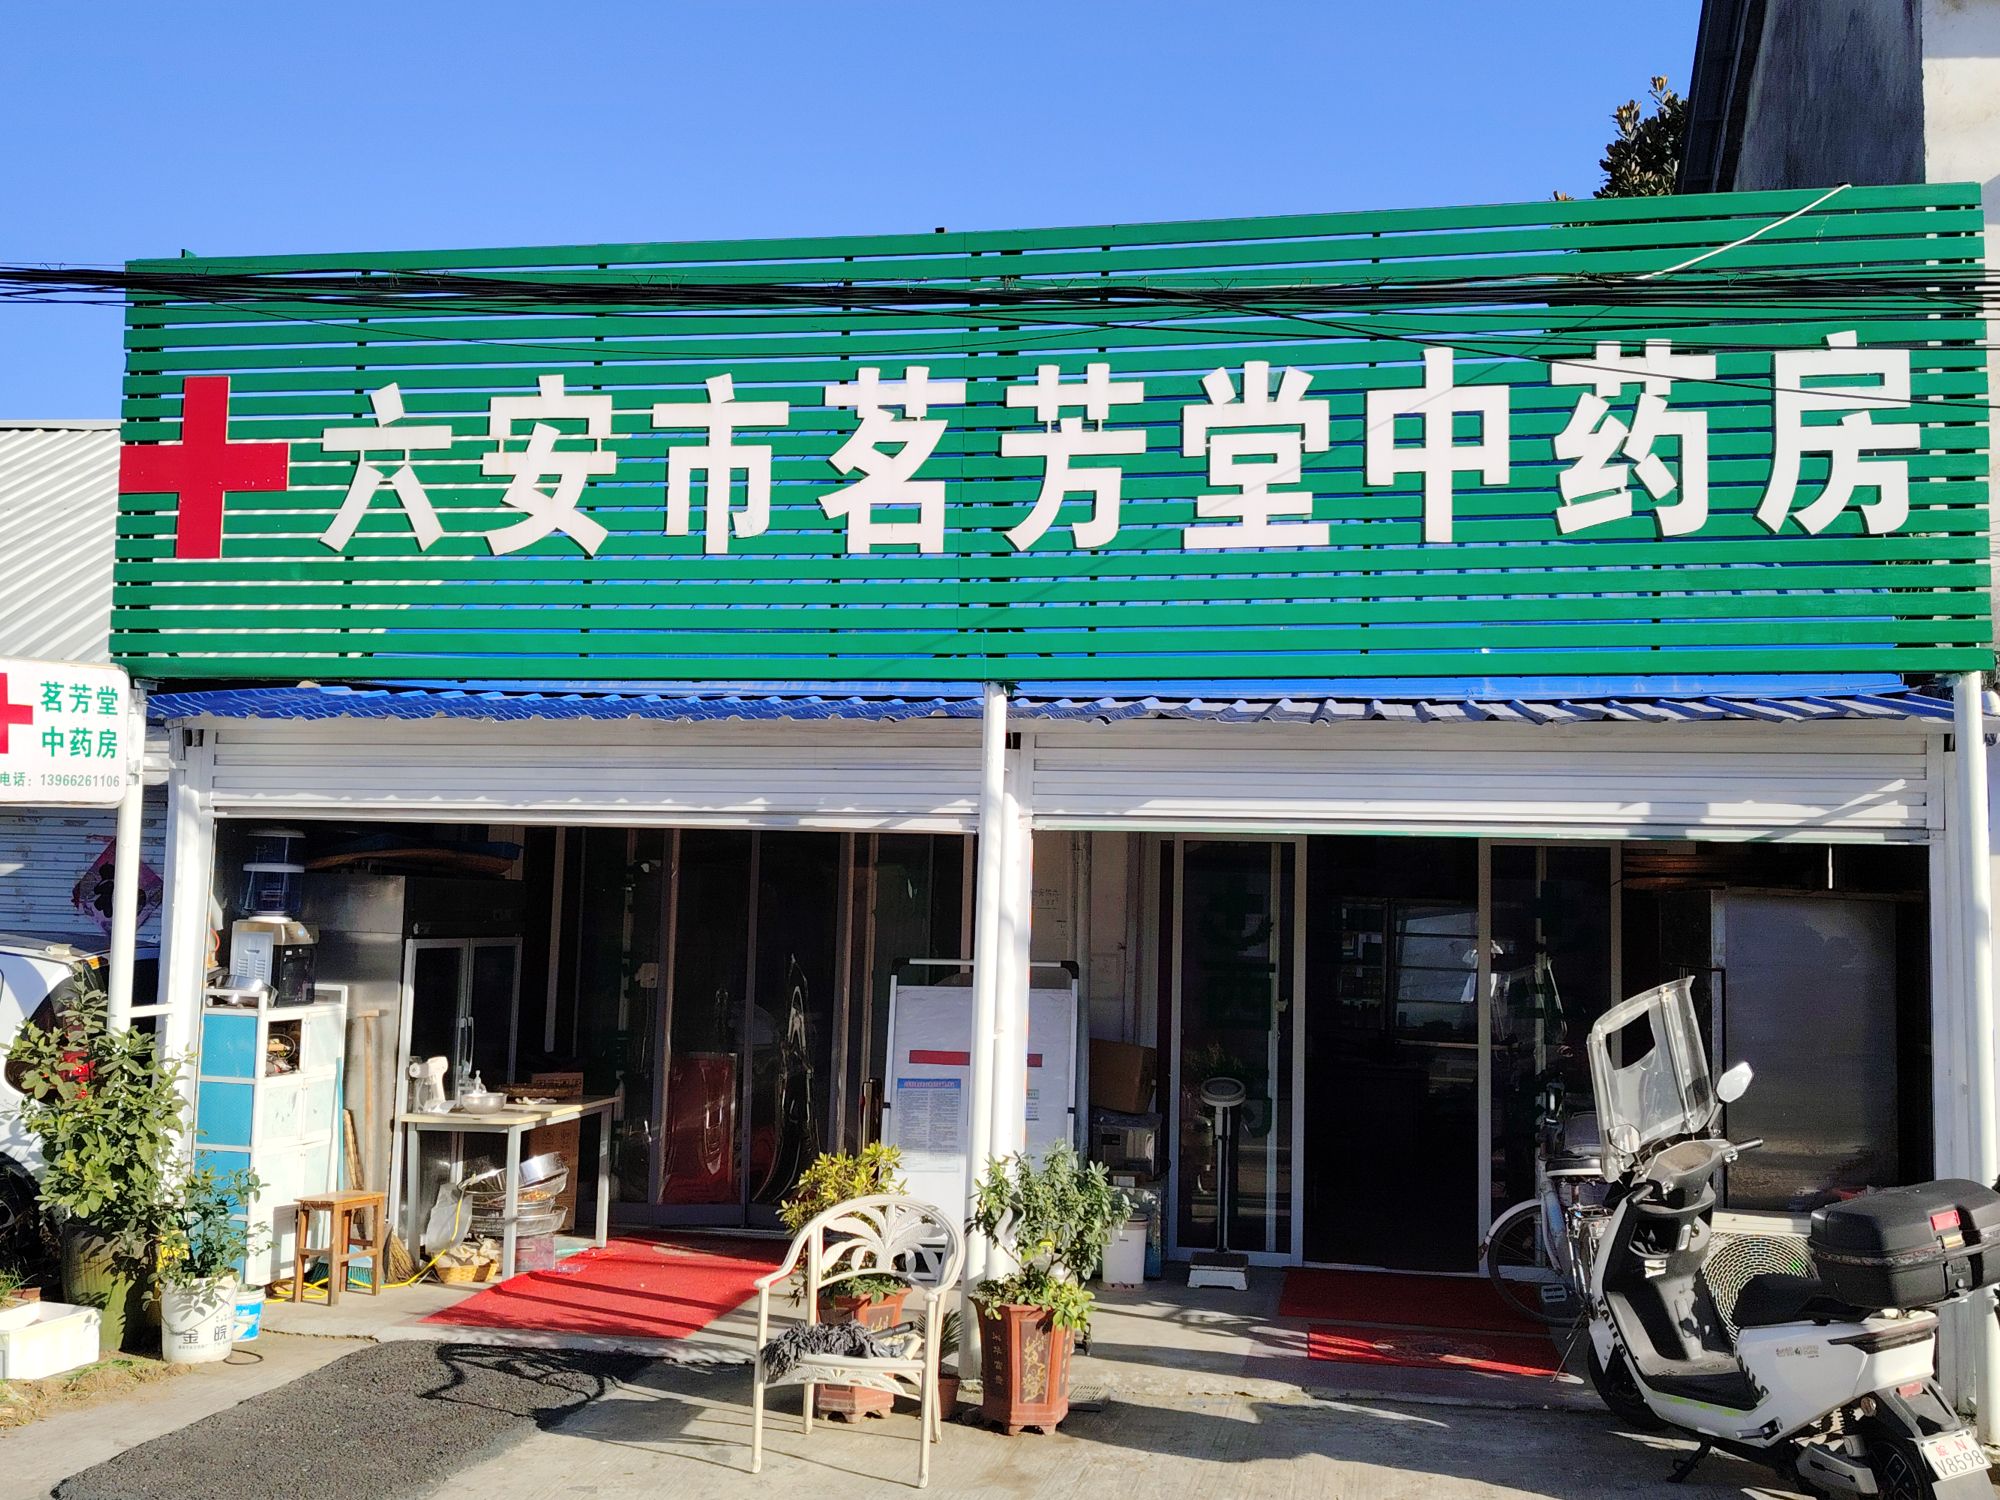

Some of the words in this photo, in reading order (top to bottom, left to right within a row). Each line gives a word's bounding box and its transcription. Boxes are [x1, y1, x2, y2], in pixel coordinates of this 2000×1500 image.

[319, 331, 1921, 556] 六安市茗芳堂中药房
[40, 681, 118, 716] 茗芳堂
[42, 726, 118, 759] 中药房
[40, 773, 120, 788] 13966261106
[1935, 1449, 1985, 1475] V8598
